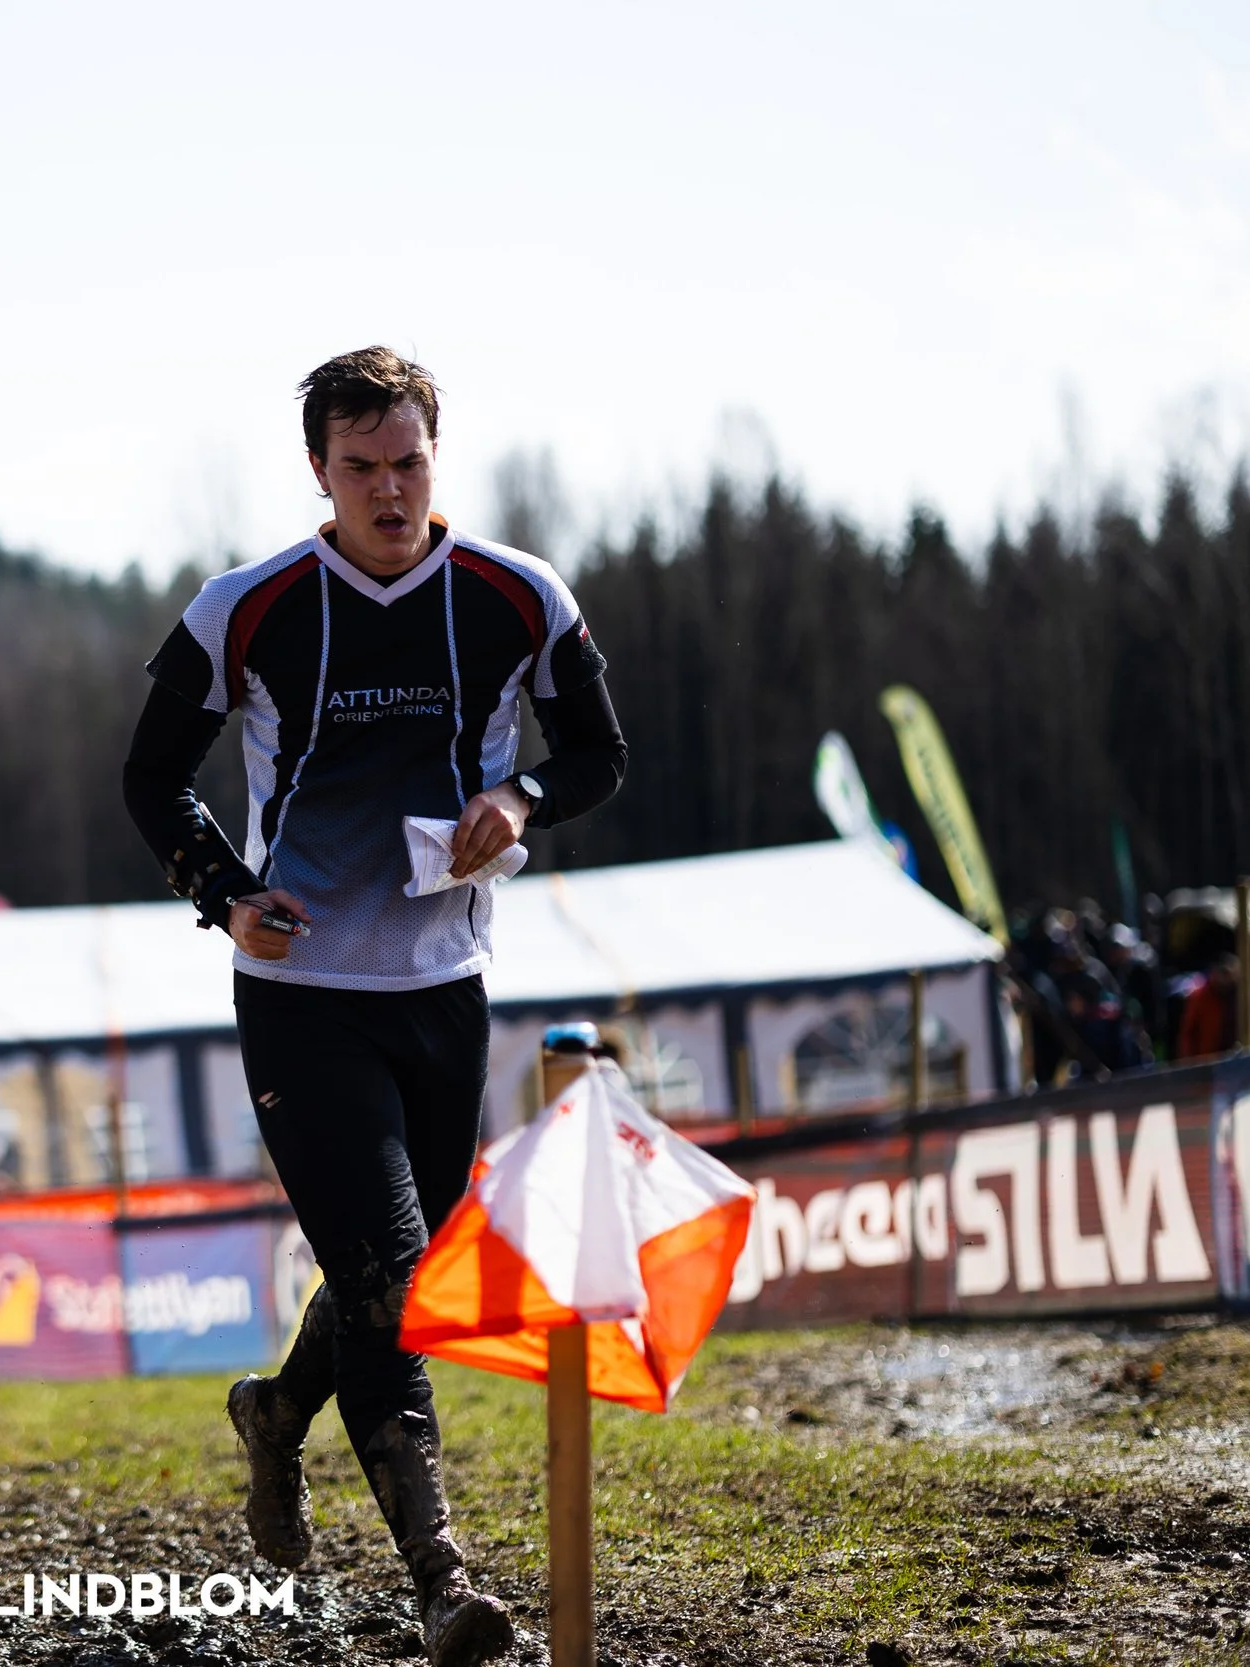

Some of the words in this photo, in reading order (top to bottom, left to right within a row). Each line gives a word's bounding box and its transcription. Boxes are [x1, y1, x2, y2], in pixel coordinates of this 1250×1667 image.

[327, 687, 451, 709] ATTUNDA
[333, 704, 444, 723] ORIENTERING
[954, 1103, 1212, 1297] SILVA
